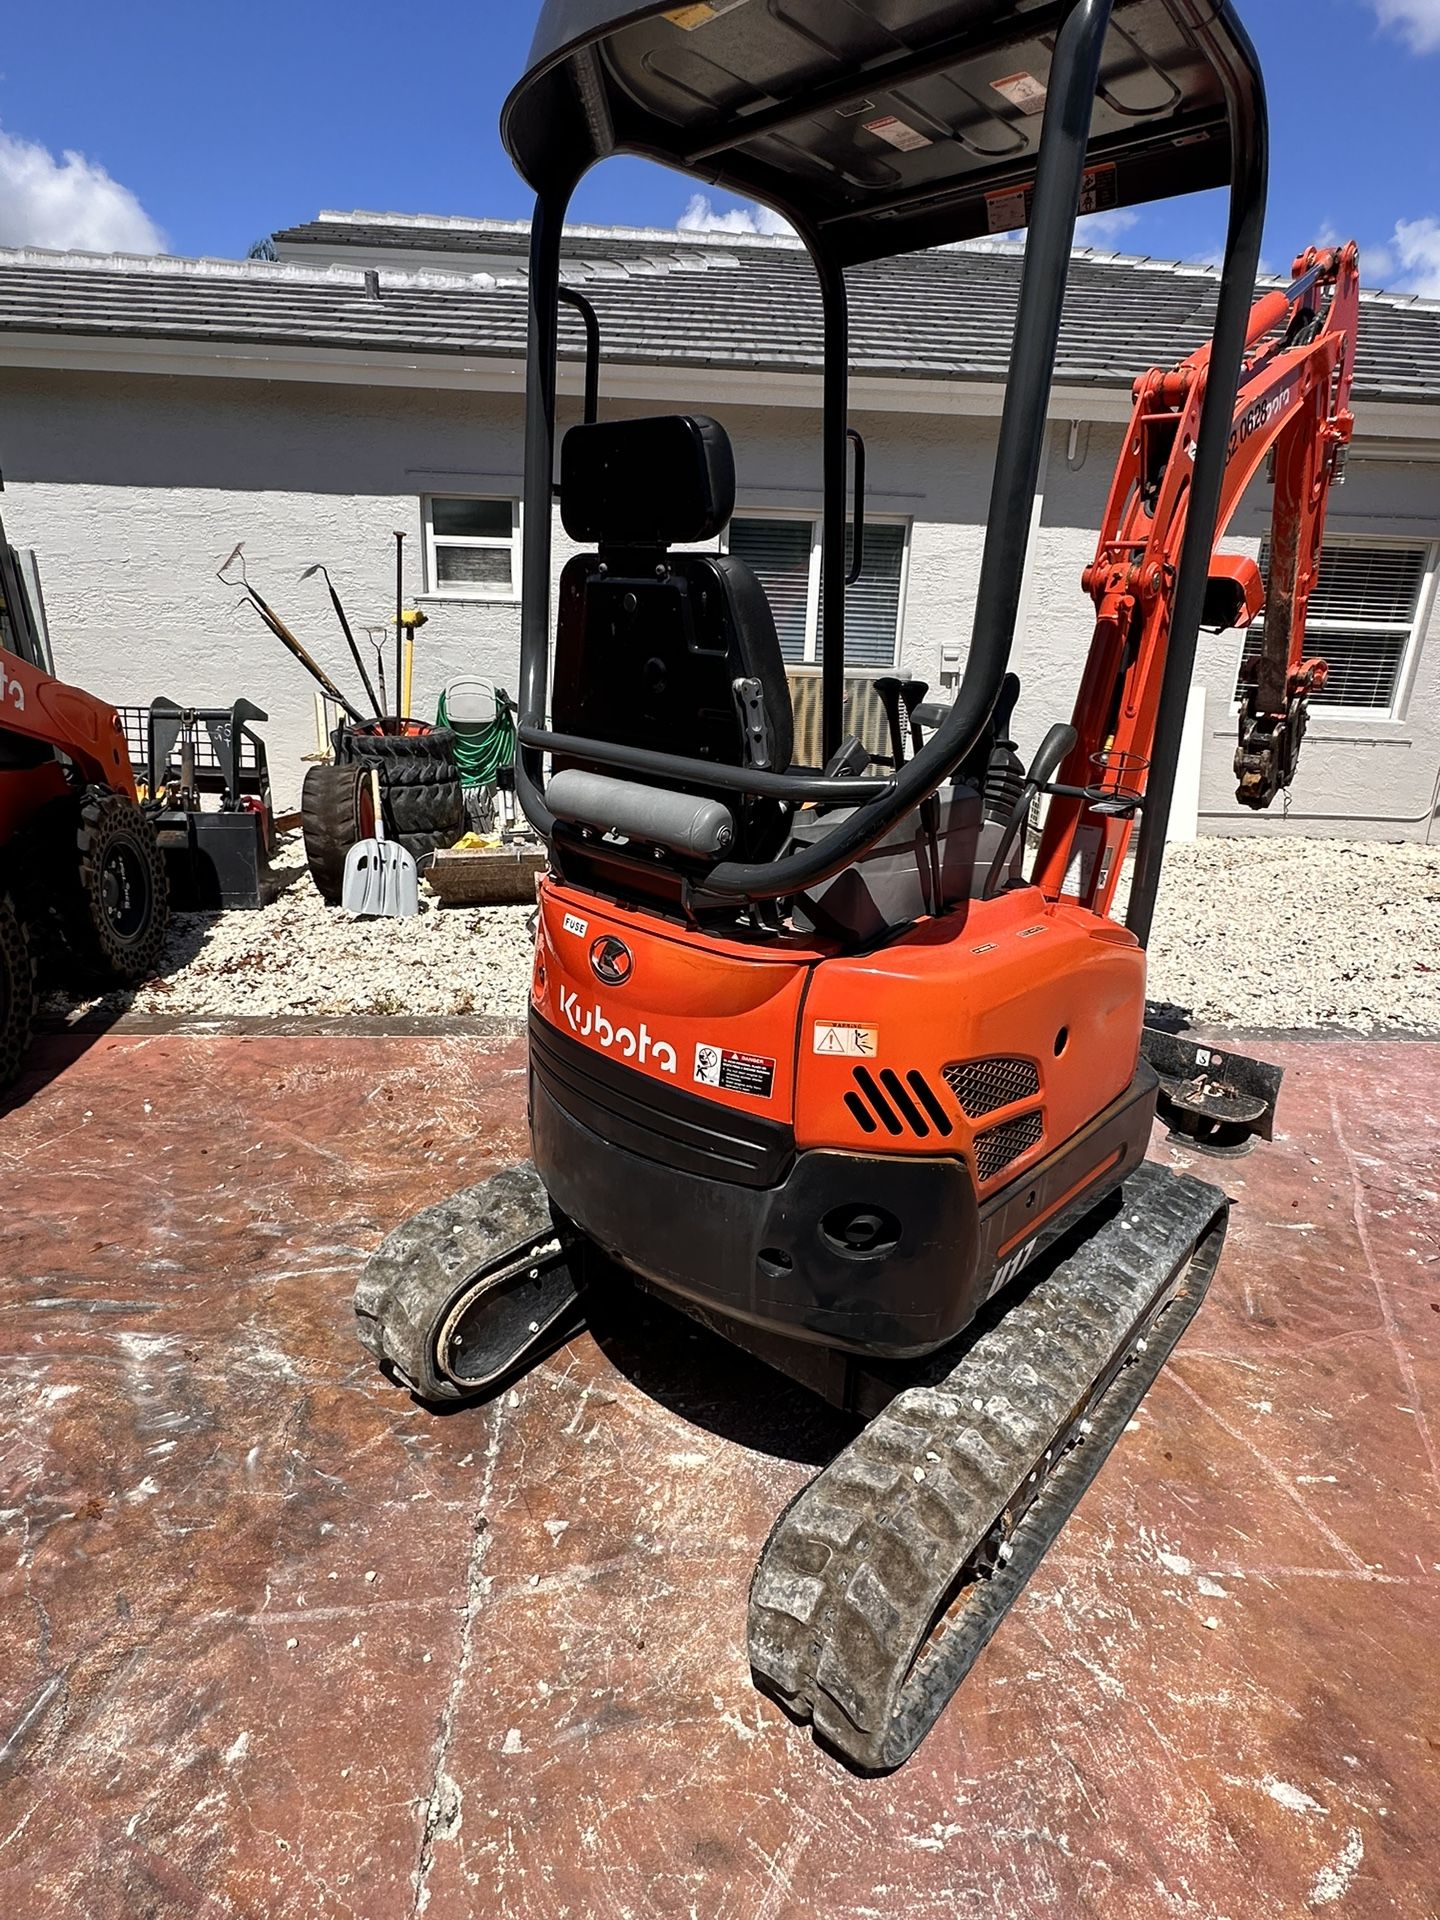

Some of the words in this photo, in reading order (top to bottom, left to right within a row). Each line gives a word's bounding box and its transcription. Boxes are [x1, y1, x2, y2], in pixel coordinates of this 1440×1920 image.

[564, 916, 586, 934] FUSE
[559, 984, 678, 1075] Kubota
[740, 1055, 766, 1065] DANGER
